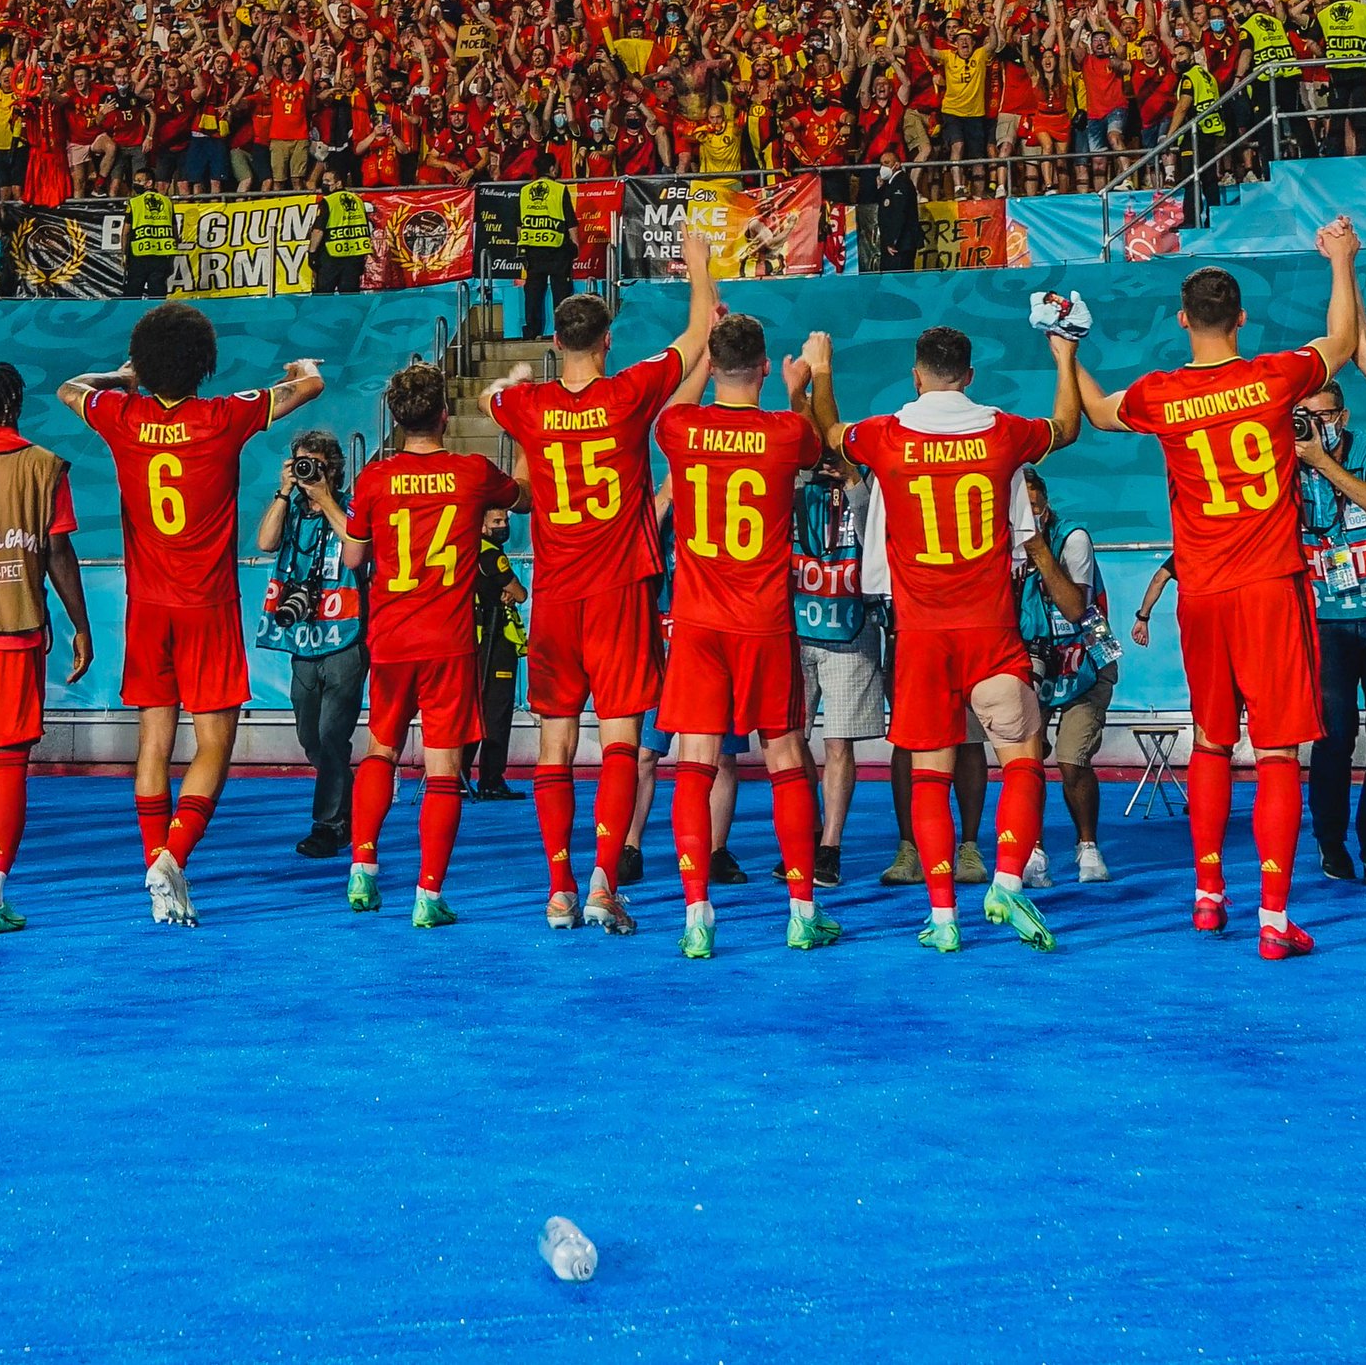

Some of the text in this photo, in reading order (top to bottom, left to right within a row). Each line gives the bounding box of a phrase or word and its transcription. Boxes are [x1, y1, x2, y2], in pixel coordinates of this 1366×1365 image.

[1326, 38, 1366, 49] ECURITY
[284, 103, 292, 115] 9
[666, 187, 717, 201] BELGIX
[102, 202, 374, 251] BLGIUM
[644, 204, 729, 227] MAKE
[135, 227, 173, 239] SECURIT
[643, 231, 673, 242] OUR
[919, 216, 992, 244] RRET
[335, 240, 370, 253] 03-16
[643, 245, 656, 258] A
[167, 245, 309, 294] ARMY
[1164, 381, 1270, 425] DENDONCKER
[543, 407, 608, 430] MEUNIER
[139, 422, 191, 444] WITSEL
[687, 428, 766, 454] T. HAZARD
[904, 438, 987, 464] E. HAZARD
[543, 437, 621, 525] 15
[1186, 421, 1279, 515] 19
[148, 452, 186, 535] 6
[391, 473, 455, 495] MERTENS
[685, 464, 766, 562] 16
[909, 472, 995, 565] 10
[388, 504, 457, 592] 14
[799, 600, 855, 629] -01
